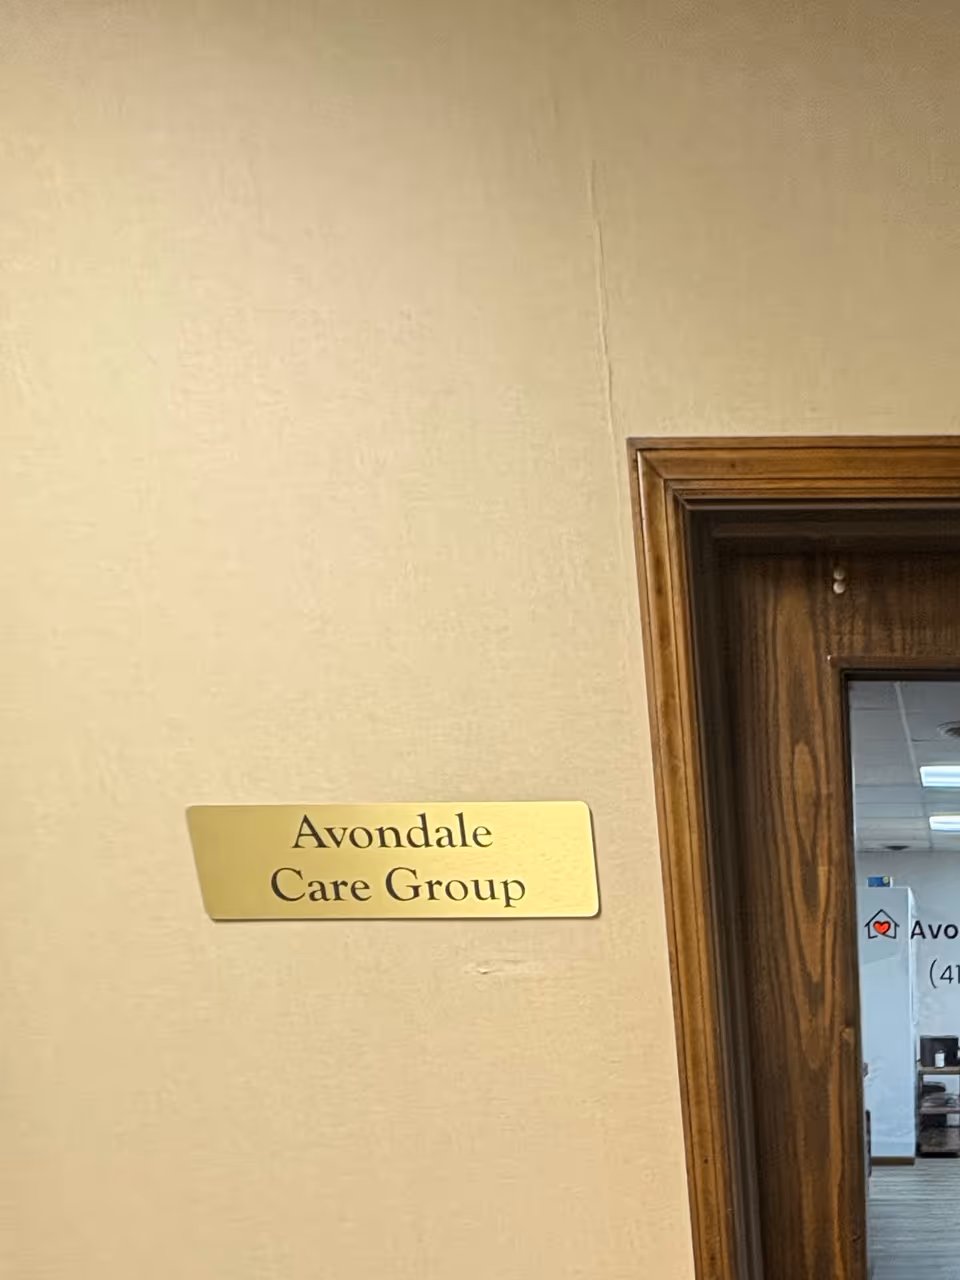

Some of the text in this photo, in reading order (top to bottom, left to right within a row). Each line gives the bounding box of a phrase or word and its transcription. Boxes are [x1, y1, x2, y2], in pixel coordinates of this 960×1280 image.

[291, 812, 494, 850] Avondale
[270, 866, 526, 908] Care Group
